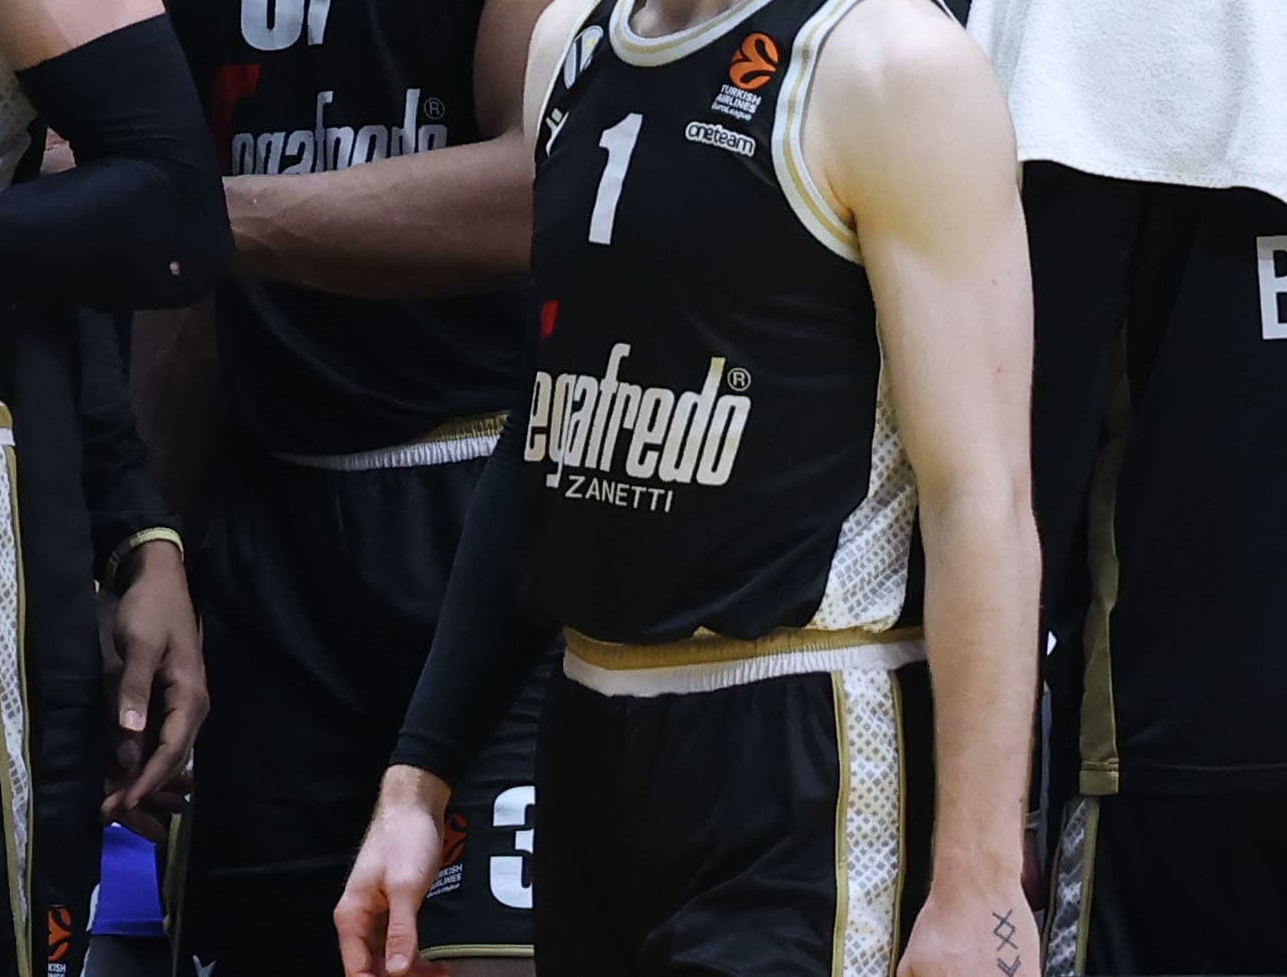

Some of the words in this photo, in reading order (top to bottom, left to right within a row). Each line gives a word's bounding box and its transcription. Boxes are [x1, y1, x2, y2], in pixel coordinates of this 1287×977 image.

[715, 93, 758, 114] AIRLINES
[720, 83, 762, 105] TURKISH
[686, 121, 756, 157] oneteam
[588, 113, 643, 245] 1
[523, 341, 752, 488] egafredo
[564, 475, 674, 513] ZANETTI
